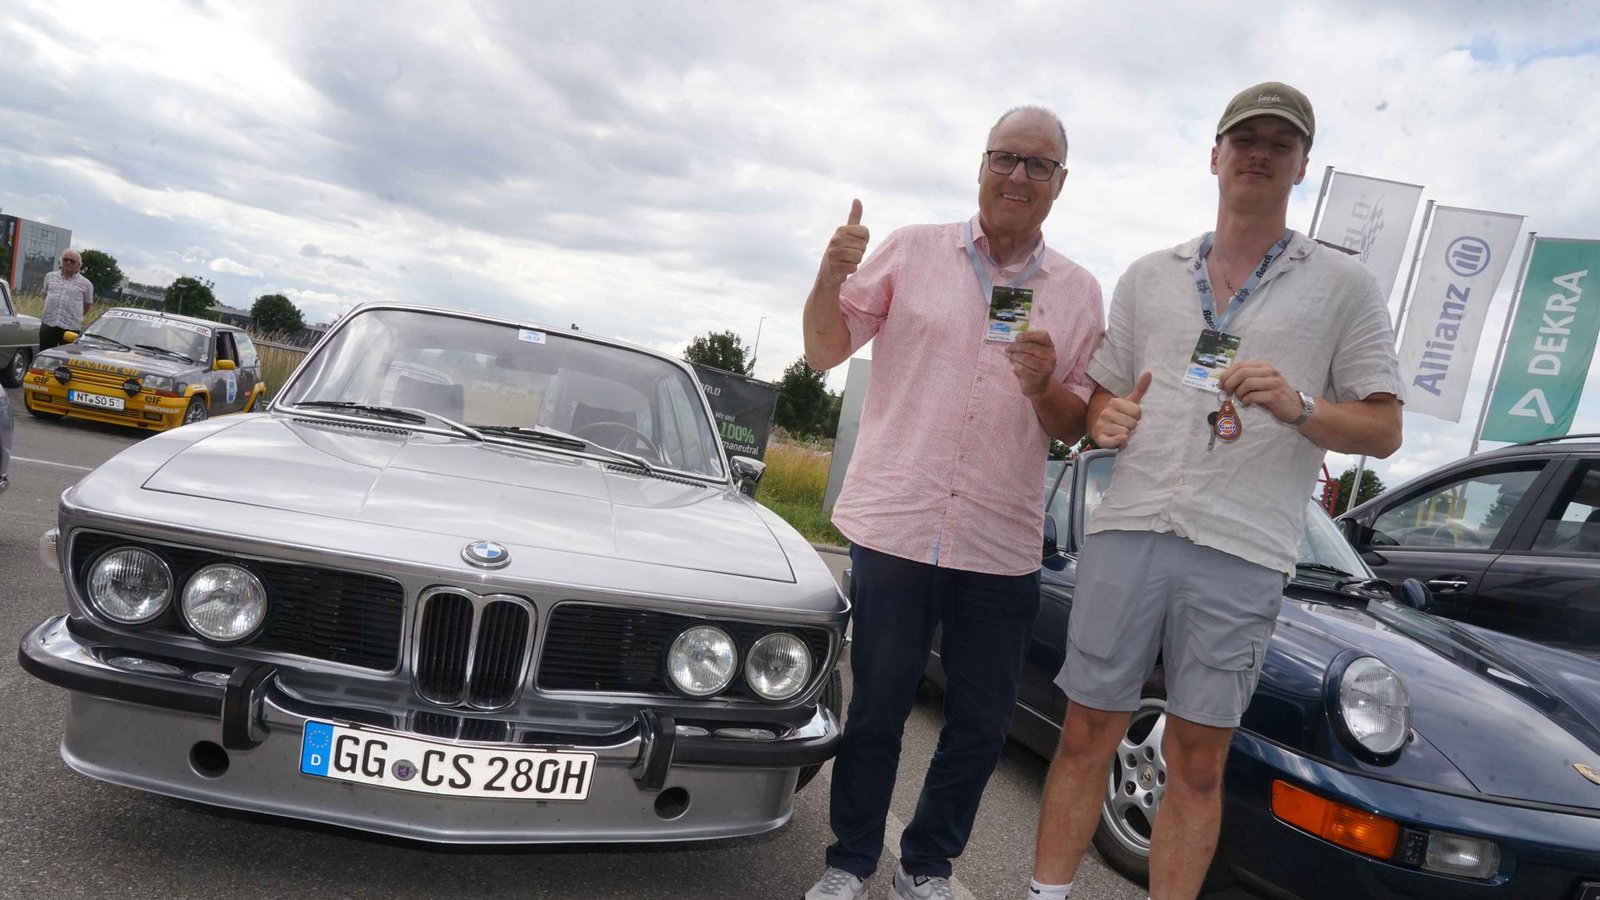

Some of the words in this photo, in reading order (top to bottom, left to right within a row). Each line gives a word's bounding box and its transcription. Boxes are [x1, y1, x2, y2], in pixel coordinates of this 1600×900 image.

[1342, 201, 1371, 249] RLD
[1255, 254, 1273, 278] Bosch
[1527, 269, 1589, 376] DEKRA
[1413, 283, 1471, 397] Allianz
[67, 358, 119, 373] RENAULT
[33, 375, 50, 385] elf
[76, 392, 89, 402] NT
[108, 398, 115, 407] 5
[702, 384, 721, 396] RLD
[144, 395, 162, 405] elf
[720, 421, 755, 444] 100%
[311, 754, 321, 766] D
[334, 734, 388, 779] GG
[421, 750, 474, 789] CS
[483, 756, 588, 794] 280H
